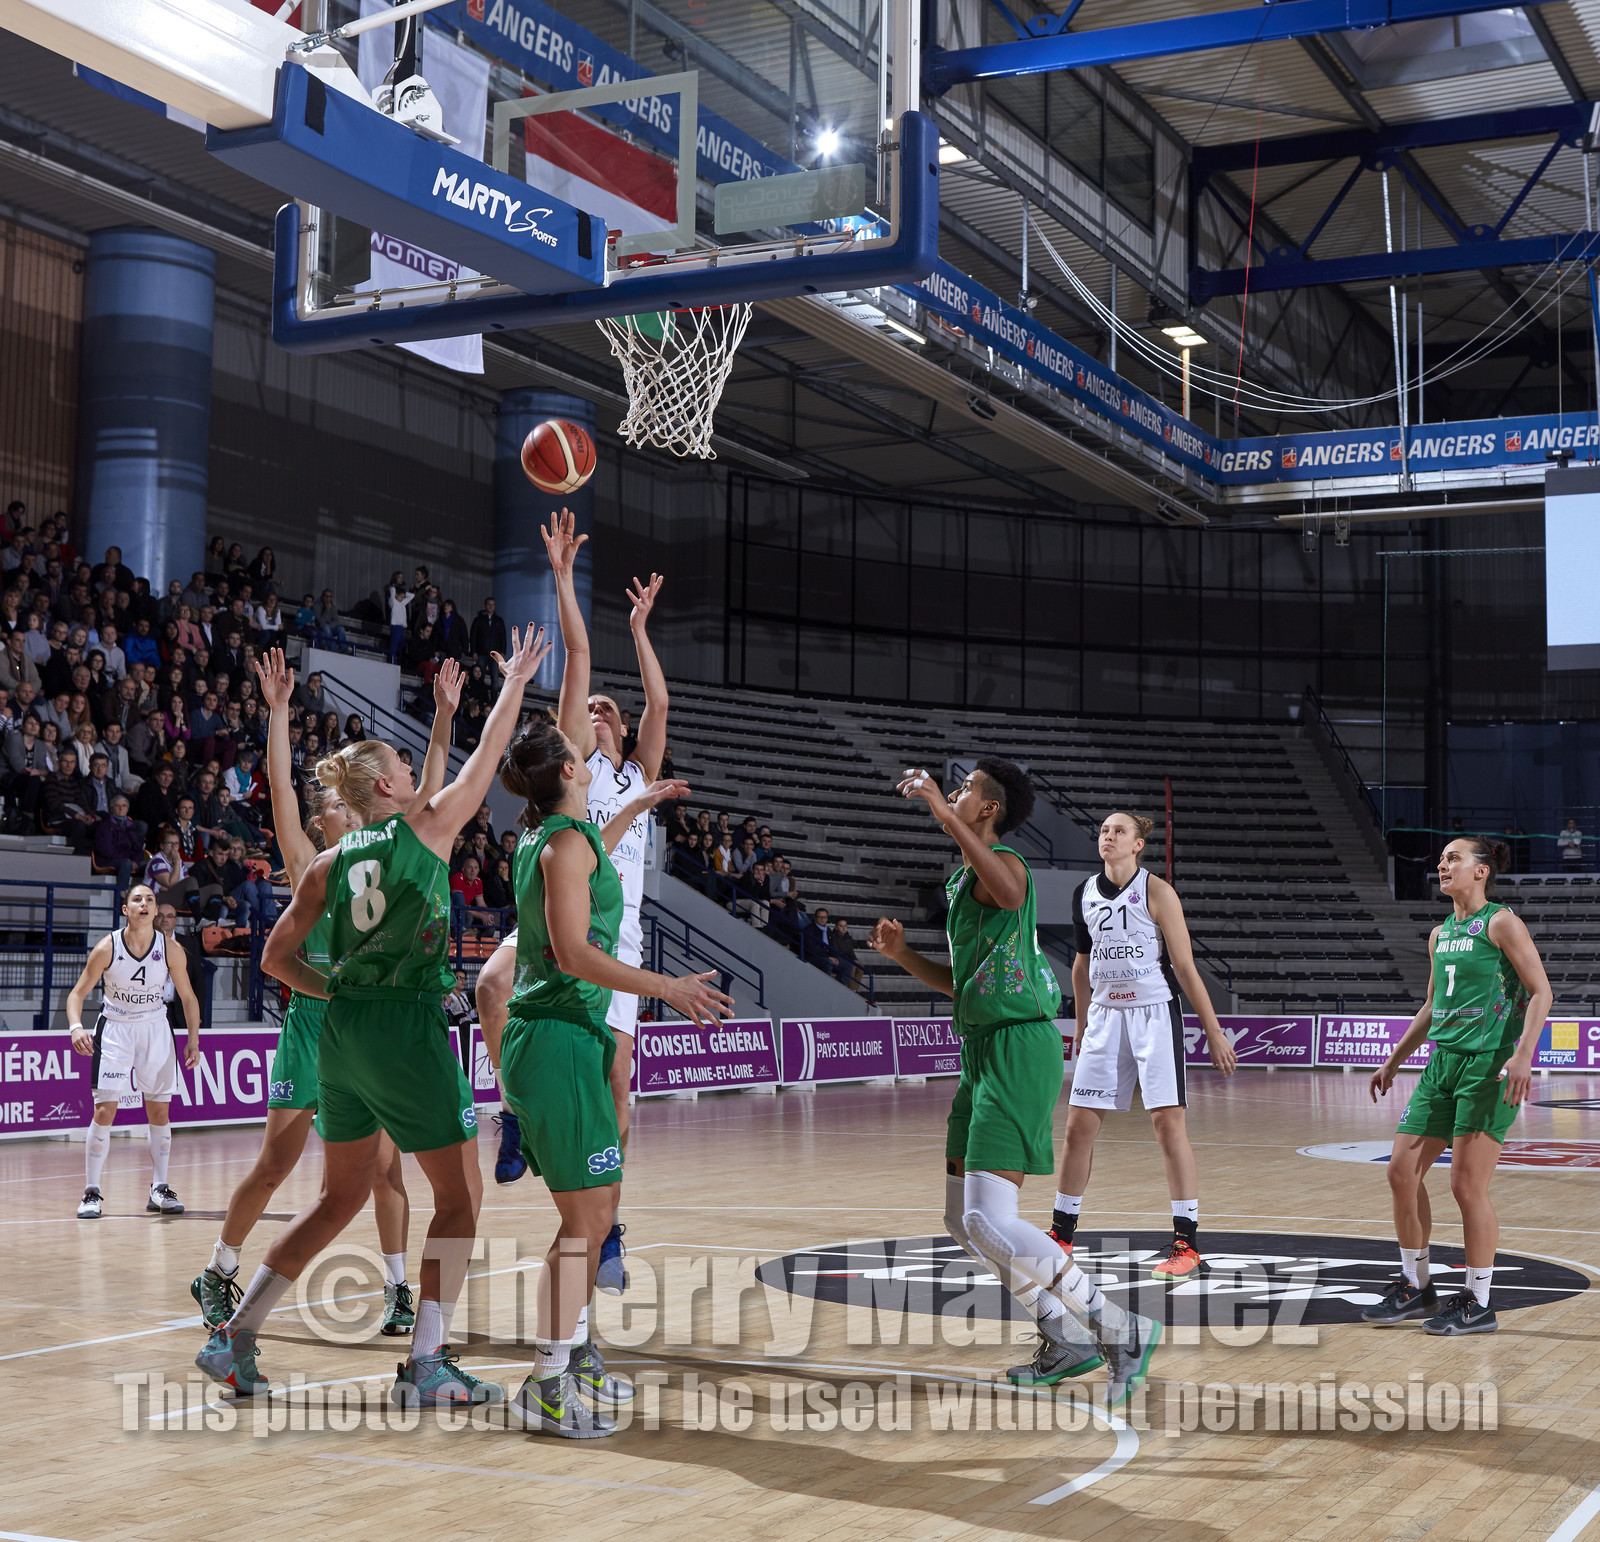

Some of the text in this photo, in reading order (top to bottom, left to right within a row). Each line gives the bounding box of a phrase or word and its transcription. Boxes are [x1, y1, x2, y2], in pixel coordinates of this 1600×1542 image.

[486, 0, 574, 73] ANGERS
[697, 125, 762, 180] ANGERS
[432, 167, 522, 225] MARTY
[921, 272, 969, 315] ANGERS
[981, 313, 1026, 351] ANGERS
[1034, 340, 1074, 382] ANGERS
[1085, 373, 1121, 411] ANGERS
[1129, 402, 1162, 436] ANGERS
[1171, 431, 1203, 460] ANGERS
[1298, 441, 1384, 467] ANGERS
[1407, 433, 1496, 459] ANGERS
[613, 773, 631, 795] 9
[348, 859, 386, 932] 8
[1099, 904, 1128, 932] 21
[1092, 944, 1144, 961] ANGERS
[1450, 937, 1474, 952] GYŐR
[130, 966, 146, 986] 4
[1445, 964, 1456, 997] 7
[112, 991, 161, 1005] ANGERS
[1108, 991, 1137, 1000] Géant
[641, 1027, 769, 1058] CONSEIL GÉNÉRAL
[897, 1023, 944, 1047] ESPACE
[1325, 1021, 1390, 1039] LABEL
[816, 1040, 883, 1058] PAYS DE LA LOIRE
[0, 1043, 80, 1083] ÉRAL
[668, 1069, 683, 1084] DE
[934, 1058, 957, 1071] ANGERS
[0, 1101, 34, 1124] IRE
